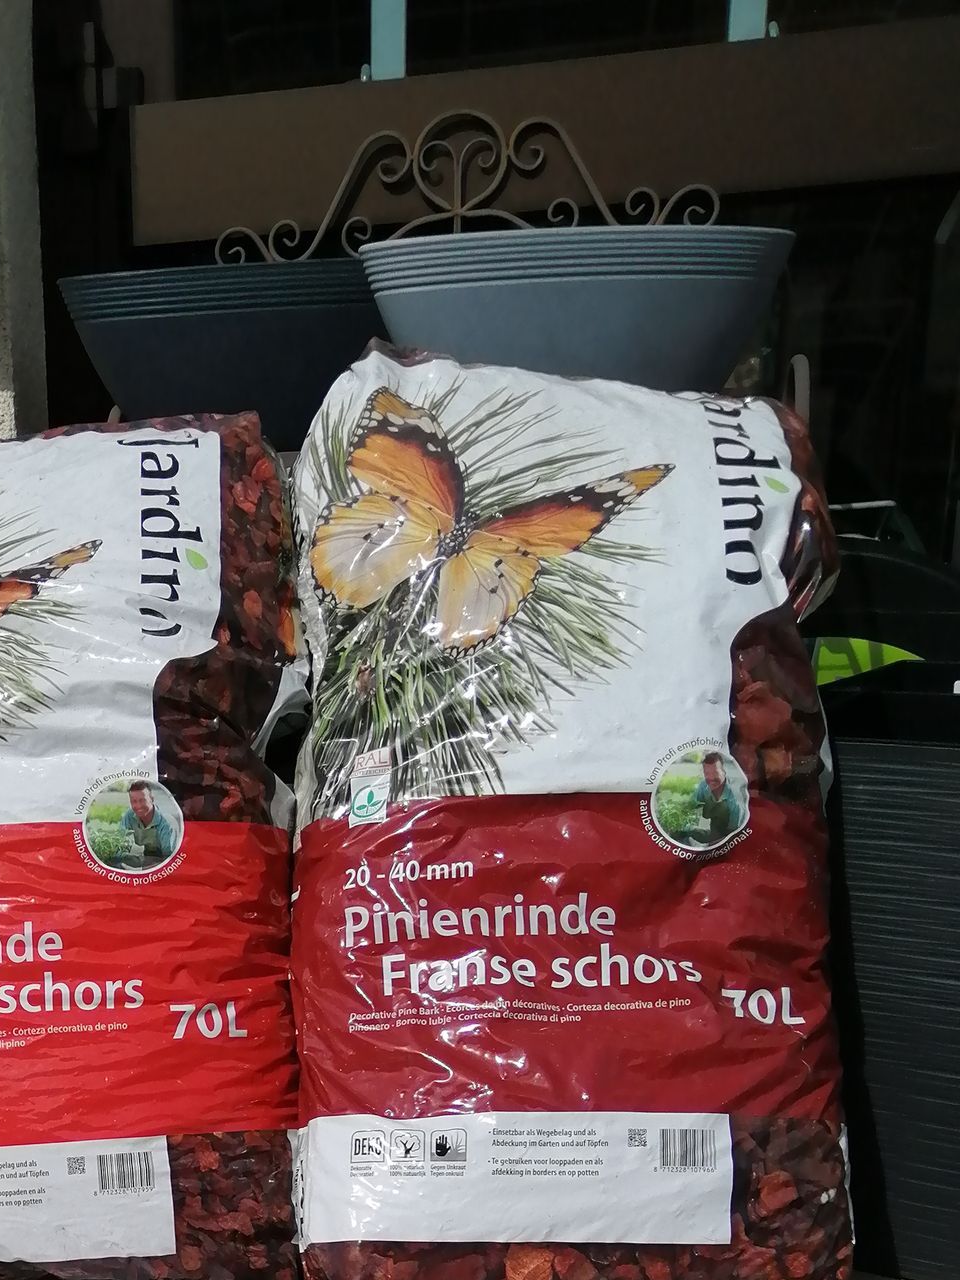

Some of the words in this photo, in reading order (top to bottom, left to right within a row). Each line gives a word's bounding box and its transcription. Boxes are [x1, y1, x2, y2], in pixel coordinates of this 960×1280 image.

[700, 401, 789, 585] ardino
[117, 438, 208, 637] Jardino
[356, 750, 388, 769] RAL
[645, 768, 660, 786] Vom
[657, 748, 677, 767] Profi
[677, 737, 724, 752] empfohlen
[85, 777, 103, 796] Profi
[103, 769, 150, 782] empfohlen
[640, 799, 671, 852] aanbevolen
[672, 848, 696, 860] door
[695, 828, 753, 862] professionals
[73, 829, 106, 877] aanbevolen
[108, 872, 130, 885] door
[133, 852, 187, 886] professionals
[344, 864, 370, 890] 20
[391, 860, 420, 882] 40
[427, 860, 474, 880] mm
[344, 893, 616, 948] Pinienrinde
[382, 949, 537, 996] Franse
[551, 943, 703, 989] schors
[396, 1017, 426, 1028] Borovo
[503, 1010, 548, 1022] decorativa
[549, 1012, 558, 1022] di
[560, 1013, 581, 1024] pino
[398, 1007, 417, 1017] Pine
[419, 1006, 439, 1016] Bark
[567, 1001, 602, 1012] Corteza
[603, 1000, 653, 1011] decorativa
[655, 999, 667, 1008] de
[669, 998, 691, 1009] pino
[722, 987, 806, 1026] 70L
[12, 1025, 45, 1036] Corteza
[47, 1023, 93, 1034] decorativa
[95, 1022, 106, 1031] de
[107, 1021, 128, 1033] pino
[169, 1002, 248, 1040] 70L
[491, 1139, 527, 1149] Abdeckung
[528, 1139, 537, 1148] im
[538, 1139, 560, 1148] Garten
[561, 1139, 574, 1148] und
[575, 1139, 586, 1148] auf
[492, 1128, 525, 1137] Einsetzbar
[526, 1128, 535, 1137] als
[536, 1128, 572, 1138] Wegebelag
[573, 1128, 586, 1137] und
[587, 1128, 596, 1137] als
[16, 1161, 28, 1169] und
[29, 1160, 38, 1168] als
[491, 1168, 524, 1179] afdekking
[532, 1168, 557, 1177] borders
[578, 1168, 599, 1179] potten
[500, 1157, 533, 1167] gebruiken
[533, 1158, 548, 1166] voor
[549, 1157, 584, 1168] looppaden
[594, 1157, 603, 1166] als
